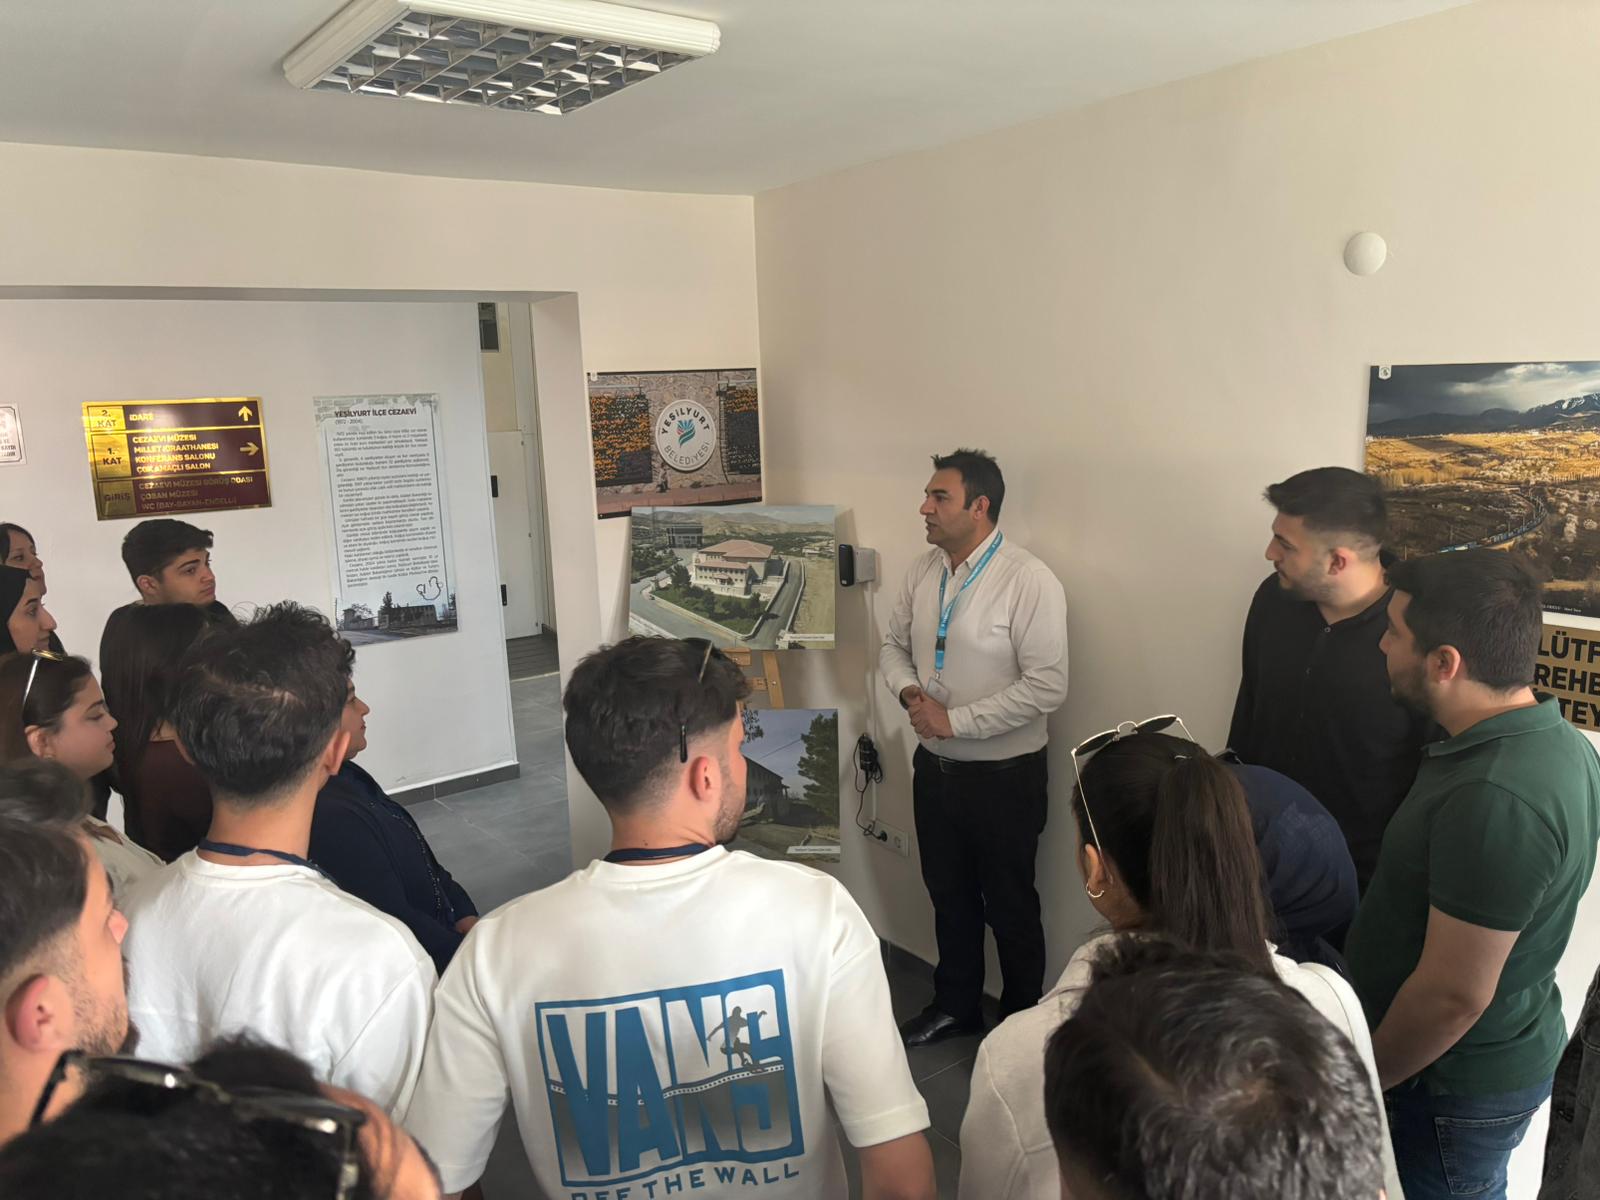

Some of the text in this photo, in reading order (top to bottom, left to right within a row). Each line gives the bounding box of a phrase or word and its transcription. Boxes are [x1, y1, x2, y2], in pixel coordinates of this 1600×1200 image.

[97, 419, 117, 427] KAT
[107, 447, 115, 455] 1.
[184, 452, 216, 461] SALONU
[102, 457, 122, 465] KAT
[185, 462, 211, 470] SALON
[143, 502, 156, 510] WC
[545, 984, 796, 1177] VANS
[642, 1168, 705, 1199] THE
[714, 1163, 799, 1186] WALL
